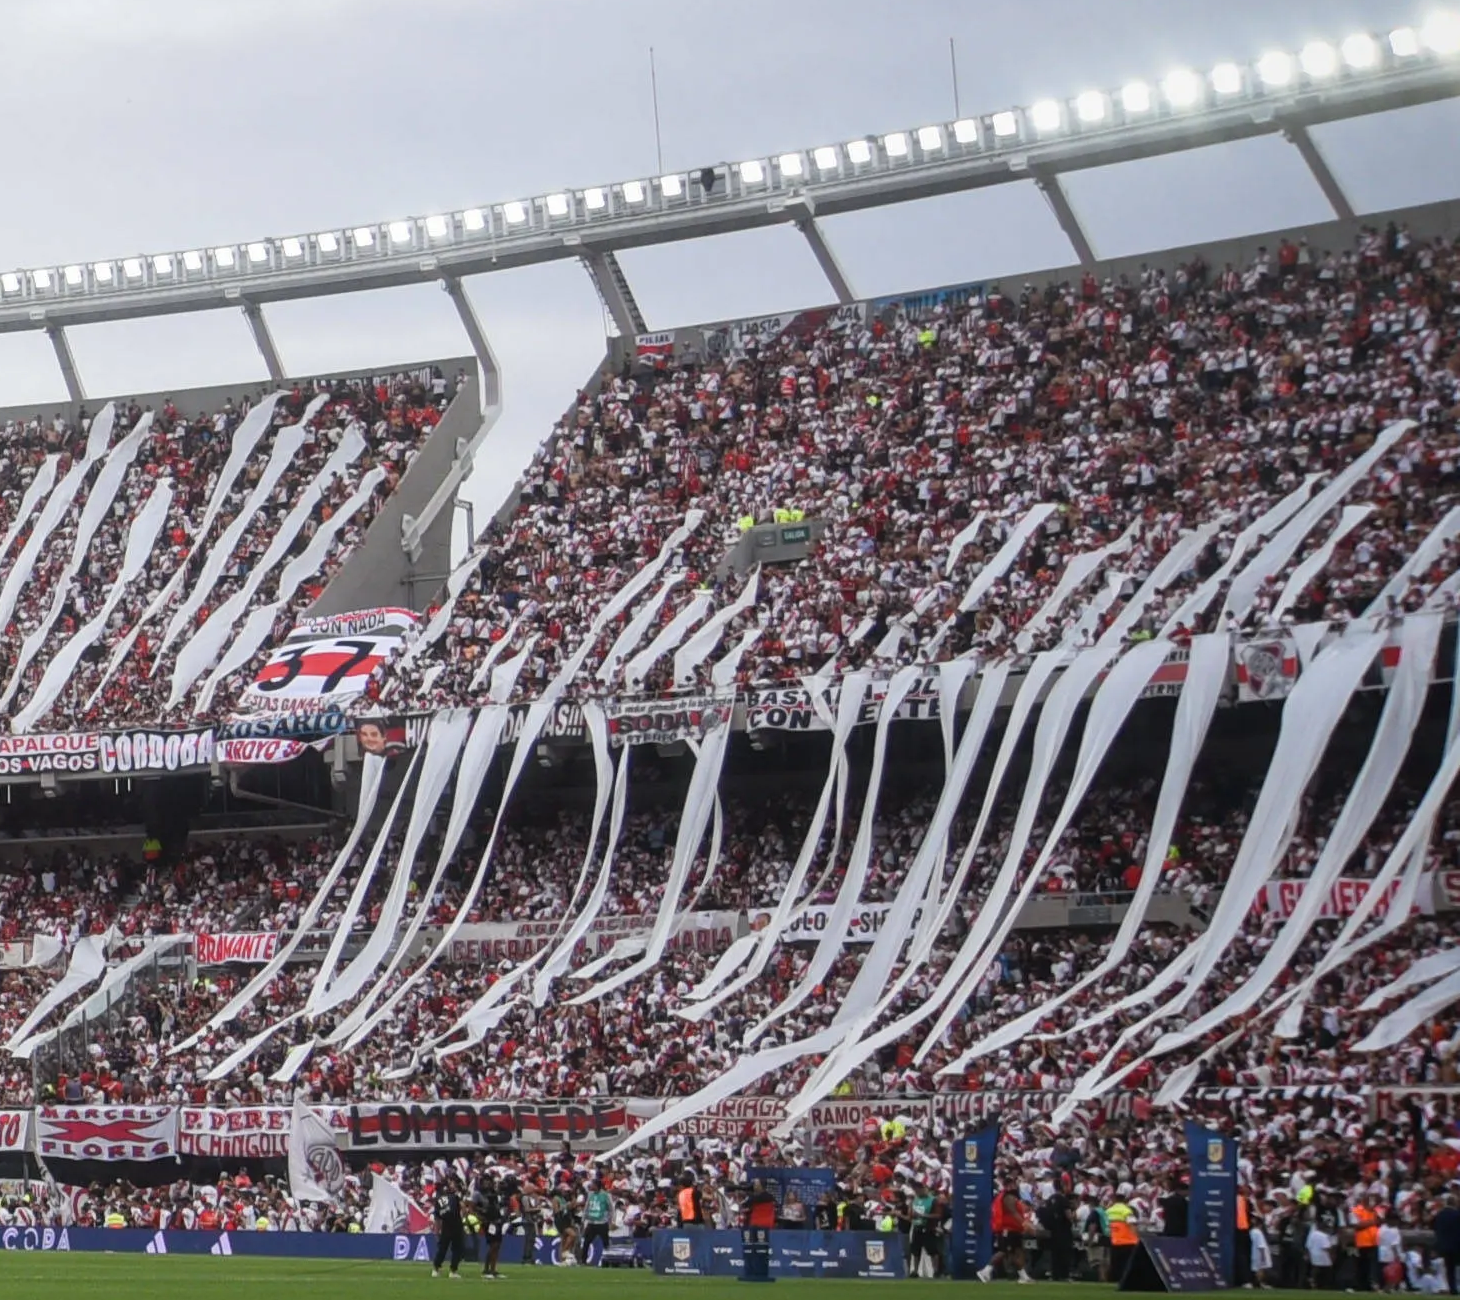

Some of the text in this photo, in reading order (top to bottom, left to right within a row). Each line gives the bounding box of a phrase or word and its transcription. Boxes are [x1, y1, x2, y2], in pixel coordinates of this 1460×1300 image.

[784, 530, 805, 540] SALIDA
[310, 619, 341, 635] CON
[347, 612, 385, 635] NADA
[257, 640, 378, 694] 37
[618, 711, 690, 732] SODA
[749, 707, 811, 730] CON
[28, 753, 95, 772] VAGOS
[39, 1105, 172, 1120] MARCELO
[350, 1104, 513, 1144] LOMAS
[42, 1142, 171, 1160] FLORES
[2, 1226, 71, 1251] COPA
